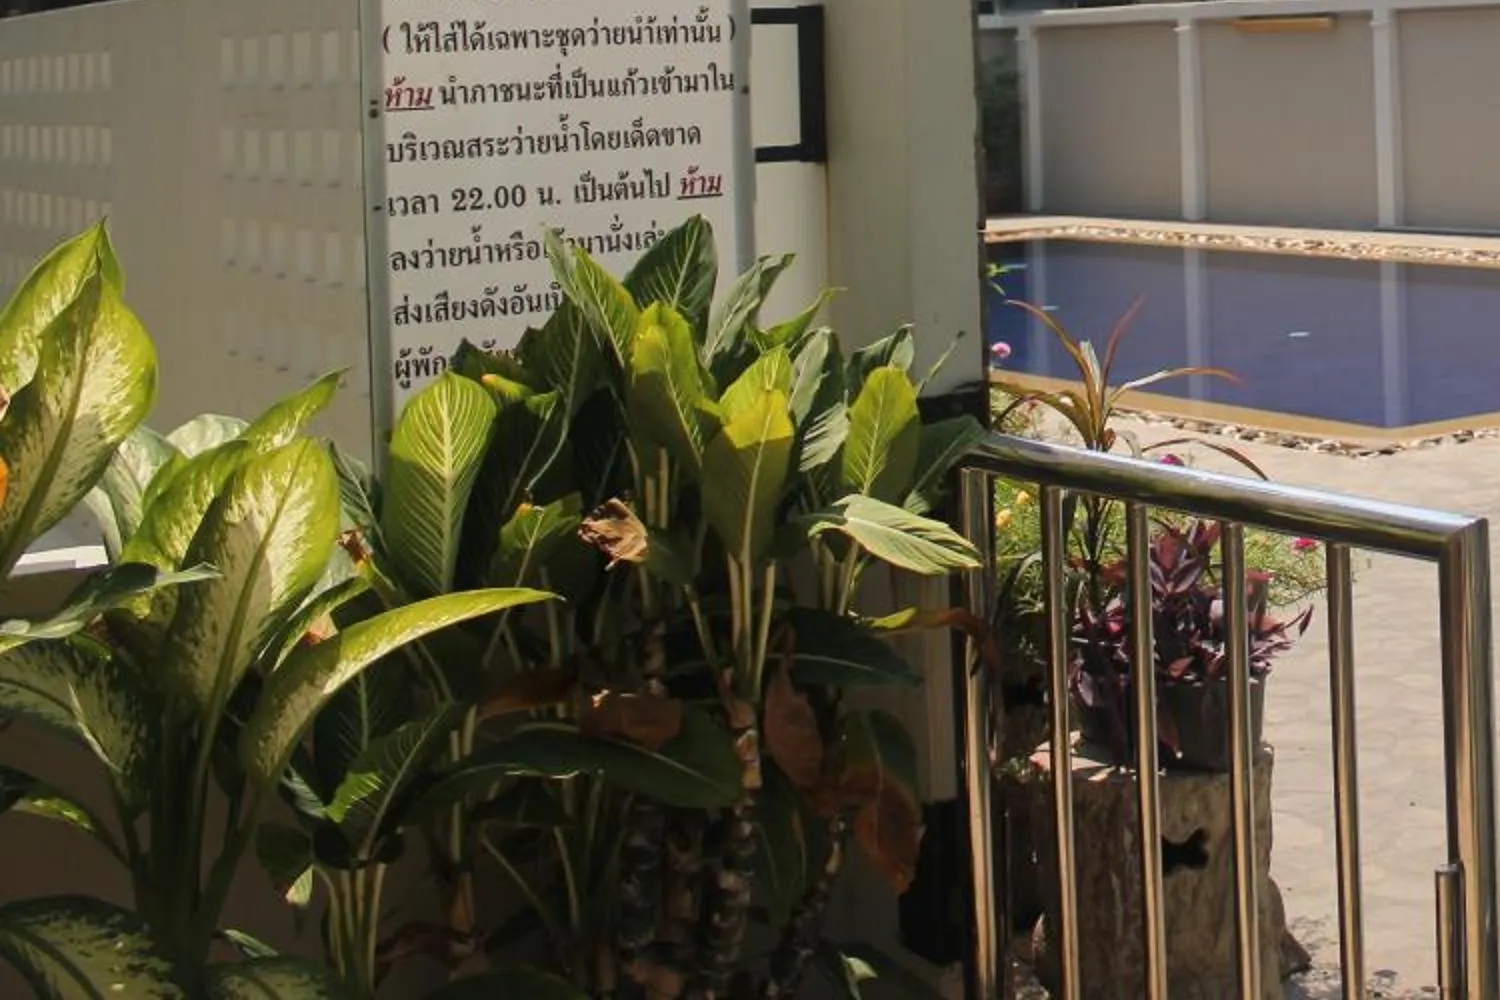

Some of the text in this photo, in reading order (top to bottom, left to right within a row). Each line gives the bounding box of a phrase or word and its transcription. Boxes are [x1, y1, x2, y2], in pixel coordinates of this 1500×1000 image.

[451, 184, 526, 212] 22.00
[537, 186, 561, 207] น.
[573, 167, 671, 204] เป็นต้นไป
[677, 166, 723, 200] ห้าม
